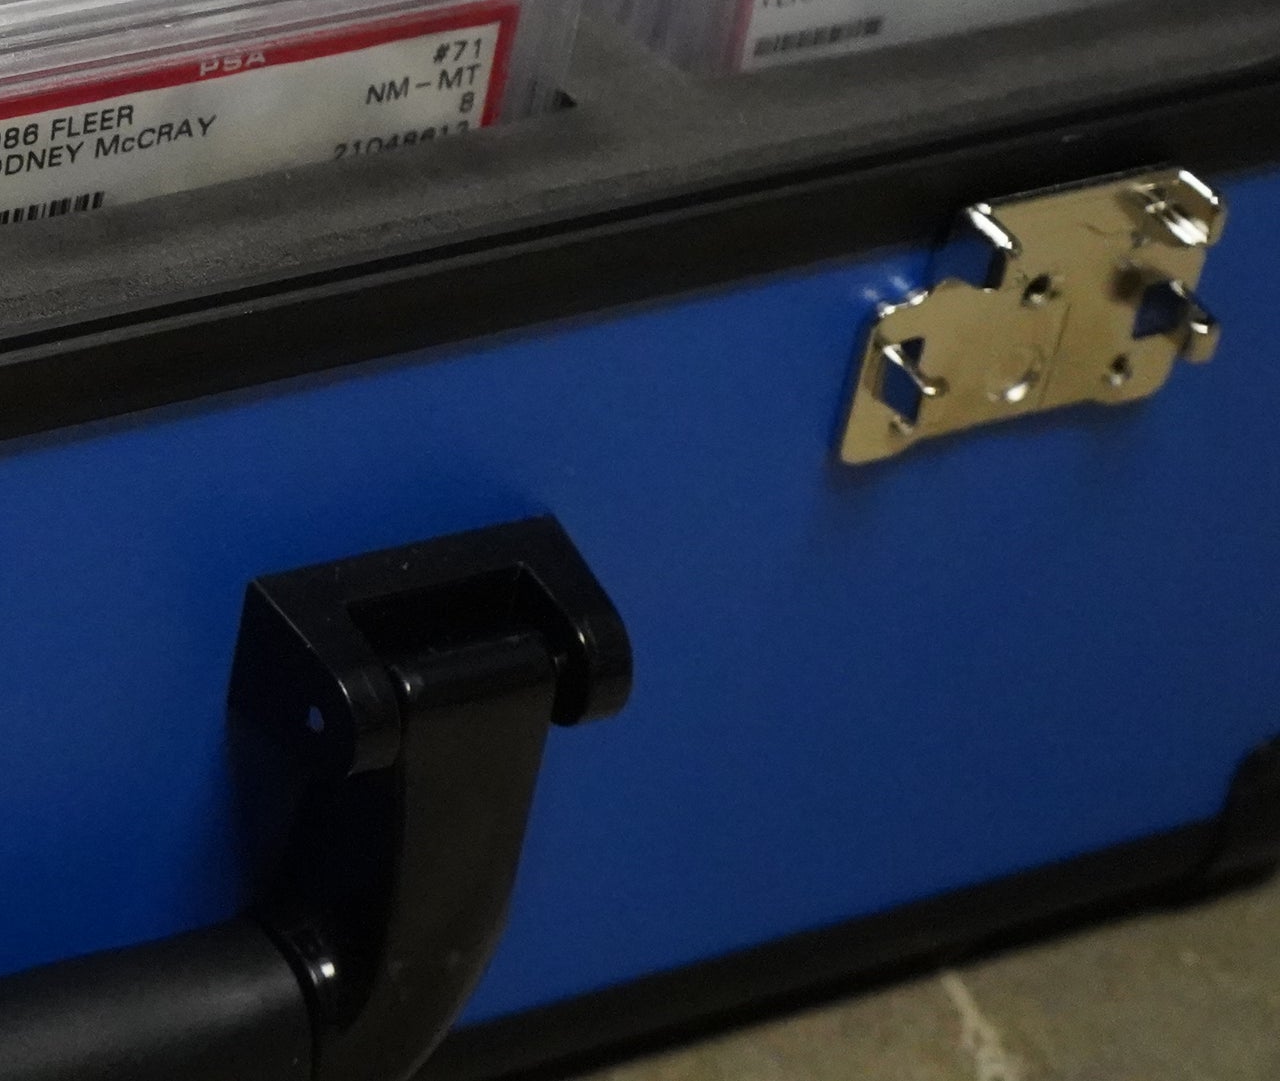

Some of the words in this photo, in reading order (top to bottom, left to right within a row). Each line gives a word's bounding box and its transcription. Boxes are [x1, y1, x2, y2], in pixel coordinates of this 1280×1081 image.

[199, 49, 267, 77] PSA
[432, 38, 483, 65] #71
[458, 91, 475, 114] 8
[50, 105, 135, 142] FLEER
[94, 114, 217, 159] McCRAY
